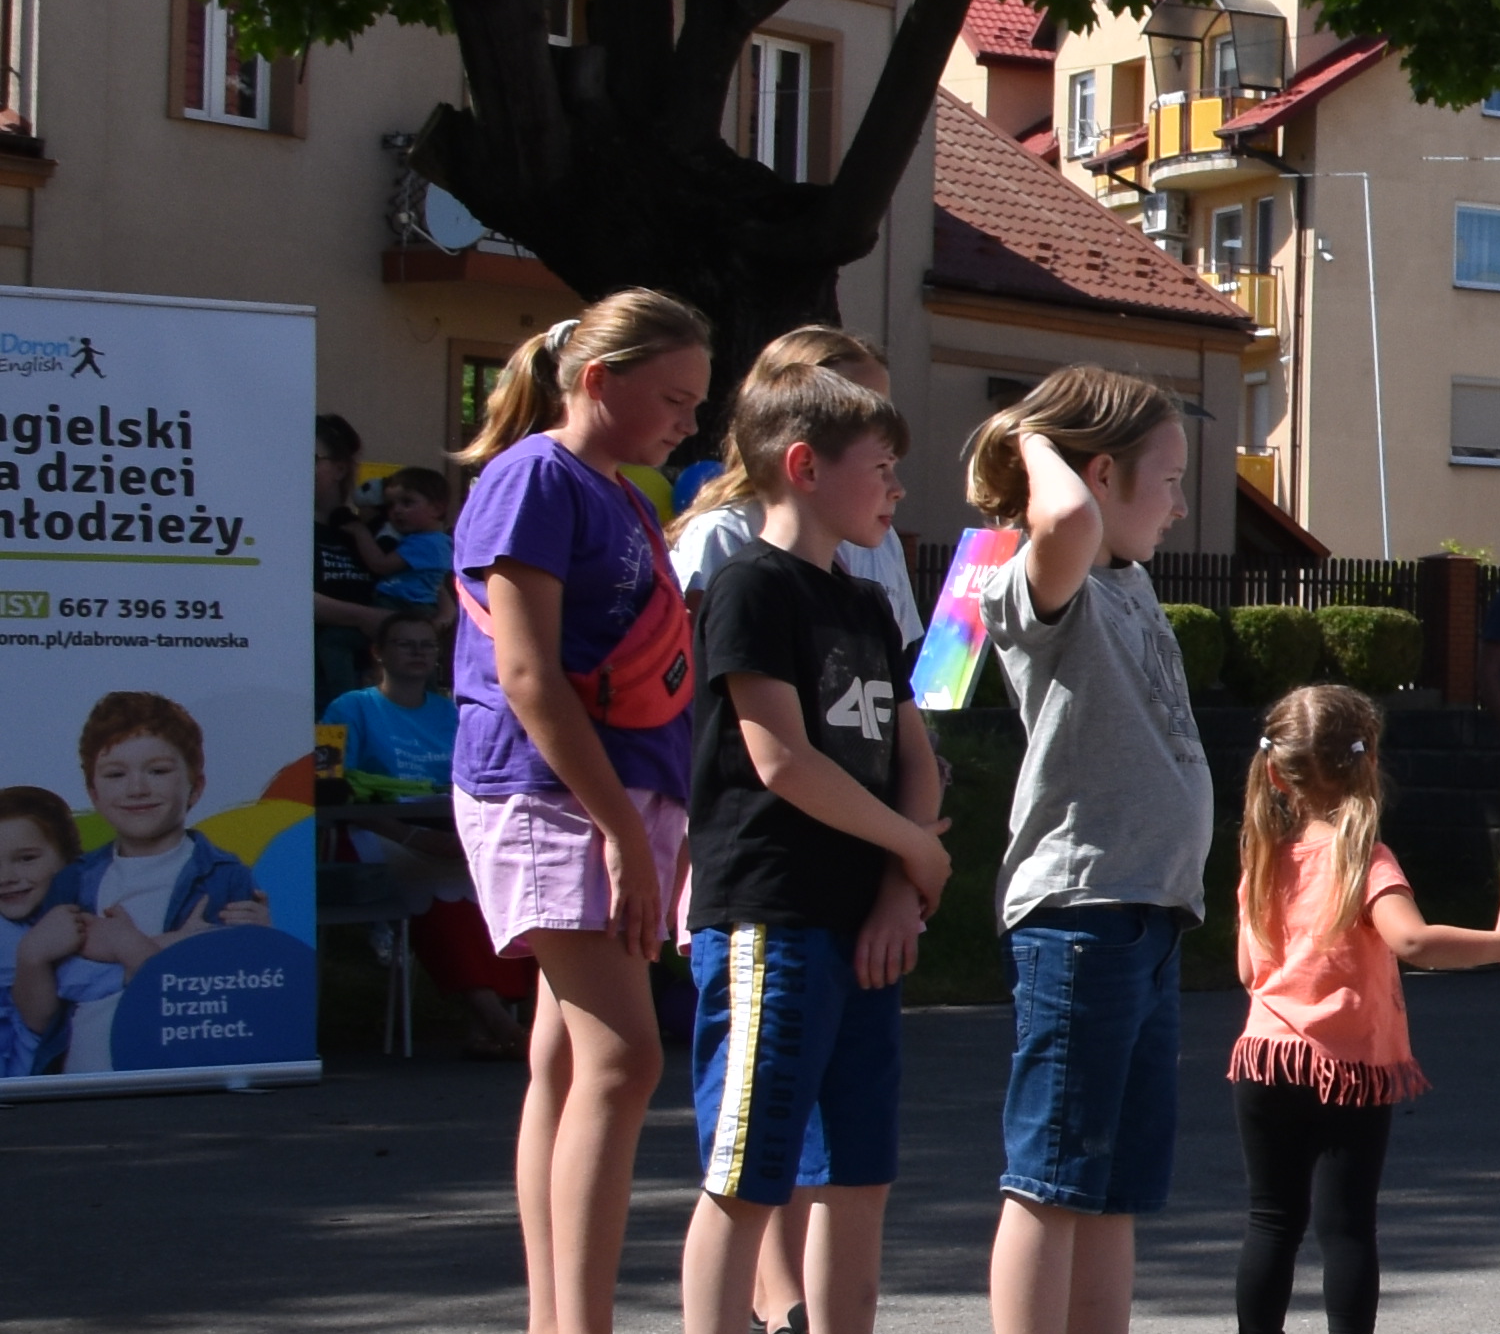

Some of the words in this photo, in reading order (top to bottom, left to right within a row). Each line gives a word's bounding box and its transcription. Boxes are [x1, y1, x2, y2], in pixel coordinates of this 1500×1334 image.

[0, 404, 191, 454] gielski
[37, 451, 194, 497] dzieci
[59, 598, 109, 617] 667
[117, 599, 167, 618] 396
[175, 600, 224, 619] 391
[826, 676, 893, 741] 4F
[161, 968, 285, 995] Przyszłość
[161, 995, 228, 1017] brzmi
[161, 1020, 254, 1046] perfect.
